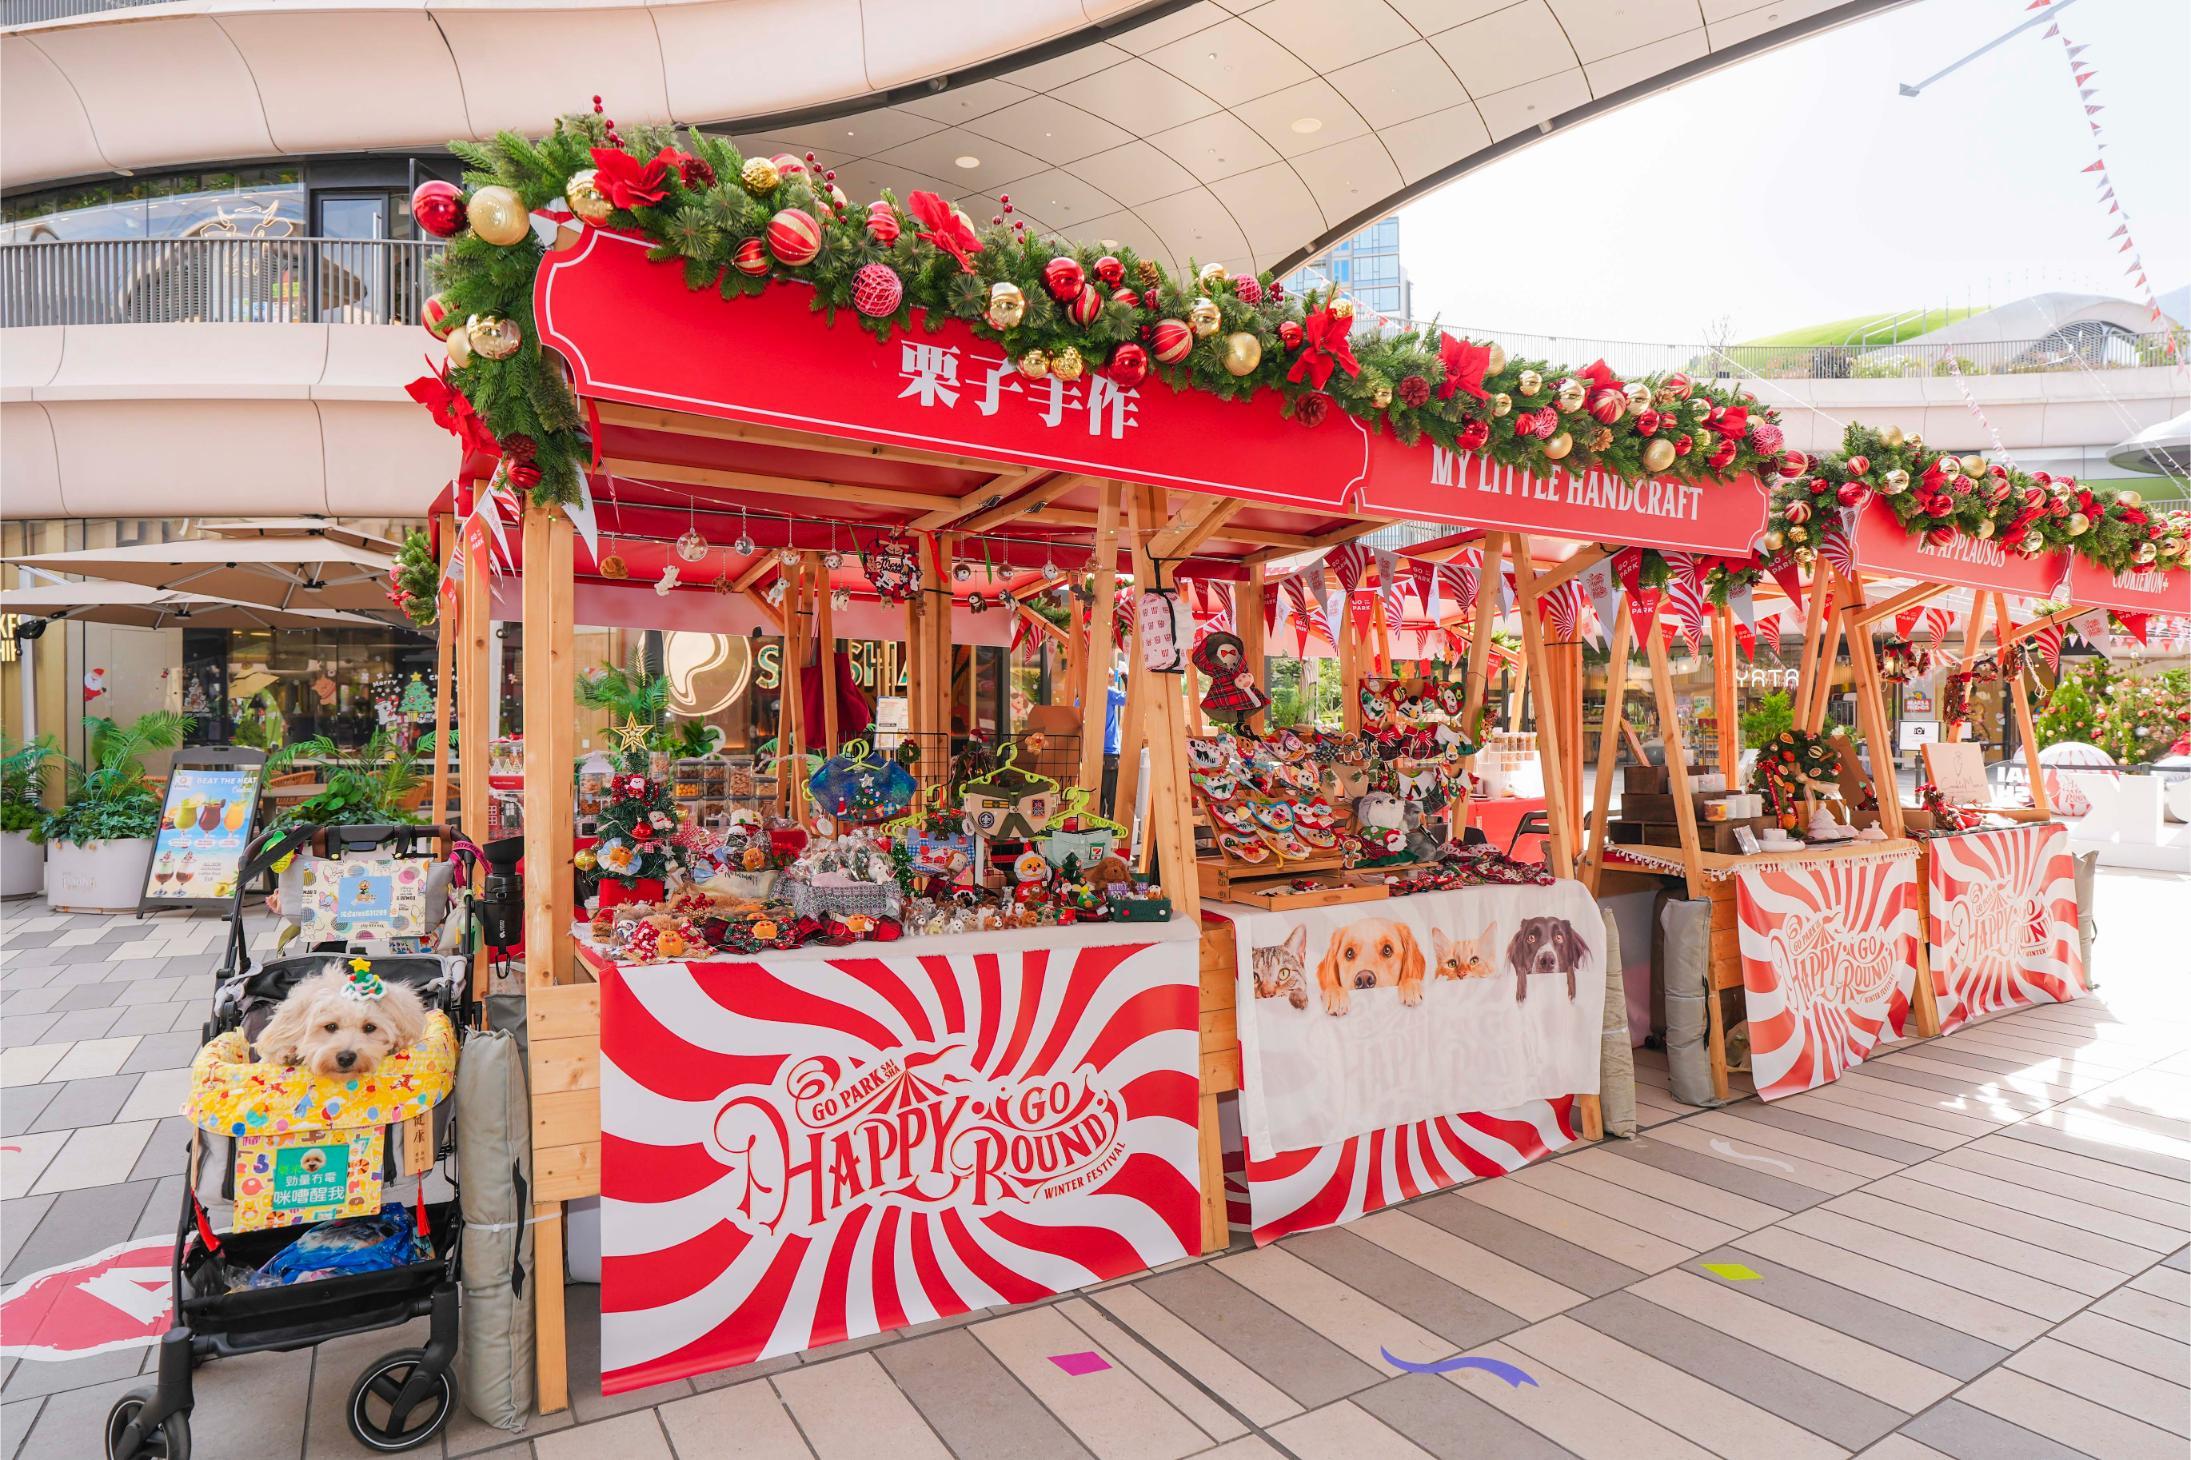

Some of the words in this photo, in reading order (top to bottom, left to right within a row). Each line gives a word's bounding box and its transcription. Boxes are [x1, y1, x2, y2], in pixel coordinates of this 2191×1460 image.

[898, 339, 1141, 439] 栗子手作
[1430, 444, 1472, 488] MY
[1566, 470, 1703, 521] HANDCRAFT
[1619, 562, 1639, 580] PARK
[1736, 668, 1799, 688] YATA
[237, 777, 258, 785] HEAT
[1857, 936, 1877, 960] GO
[1952, 900, 2014, 964] HAPPY
[1770, 936, 1842, 1014] HAPPY
[1837, 956, 1889, 1005] ROUND
[880, 1058, 895, 1072] SAI
[884, 1065, 901, 1080] SHA
[812, 1098, 838, 1122] GO
[839, 1068, 886, 1109] PARK
[1019, 1081, 1071, 1125] GO
[713, 1095, 970, 1237] HAPPY
[950, 1113, 1108, 1206] ROUND
[1043, 1176, 1085, 1199] WINTER
[1085, 1141, 1127, 1184] FESTIVAL
